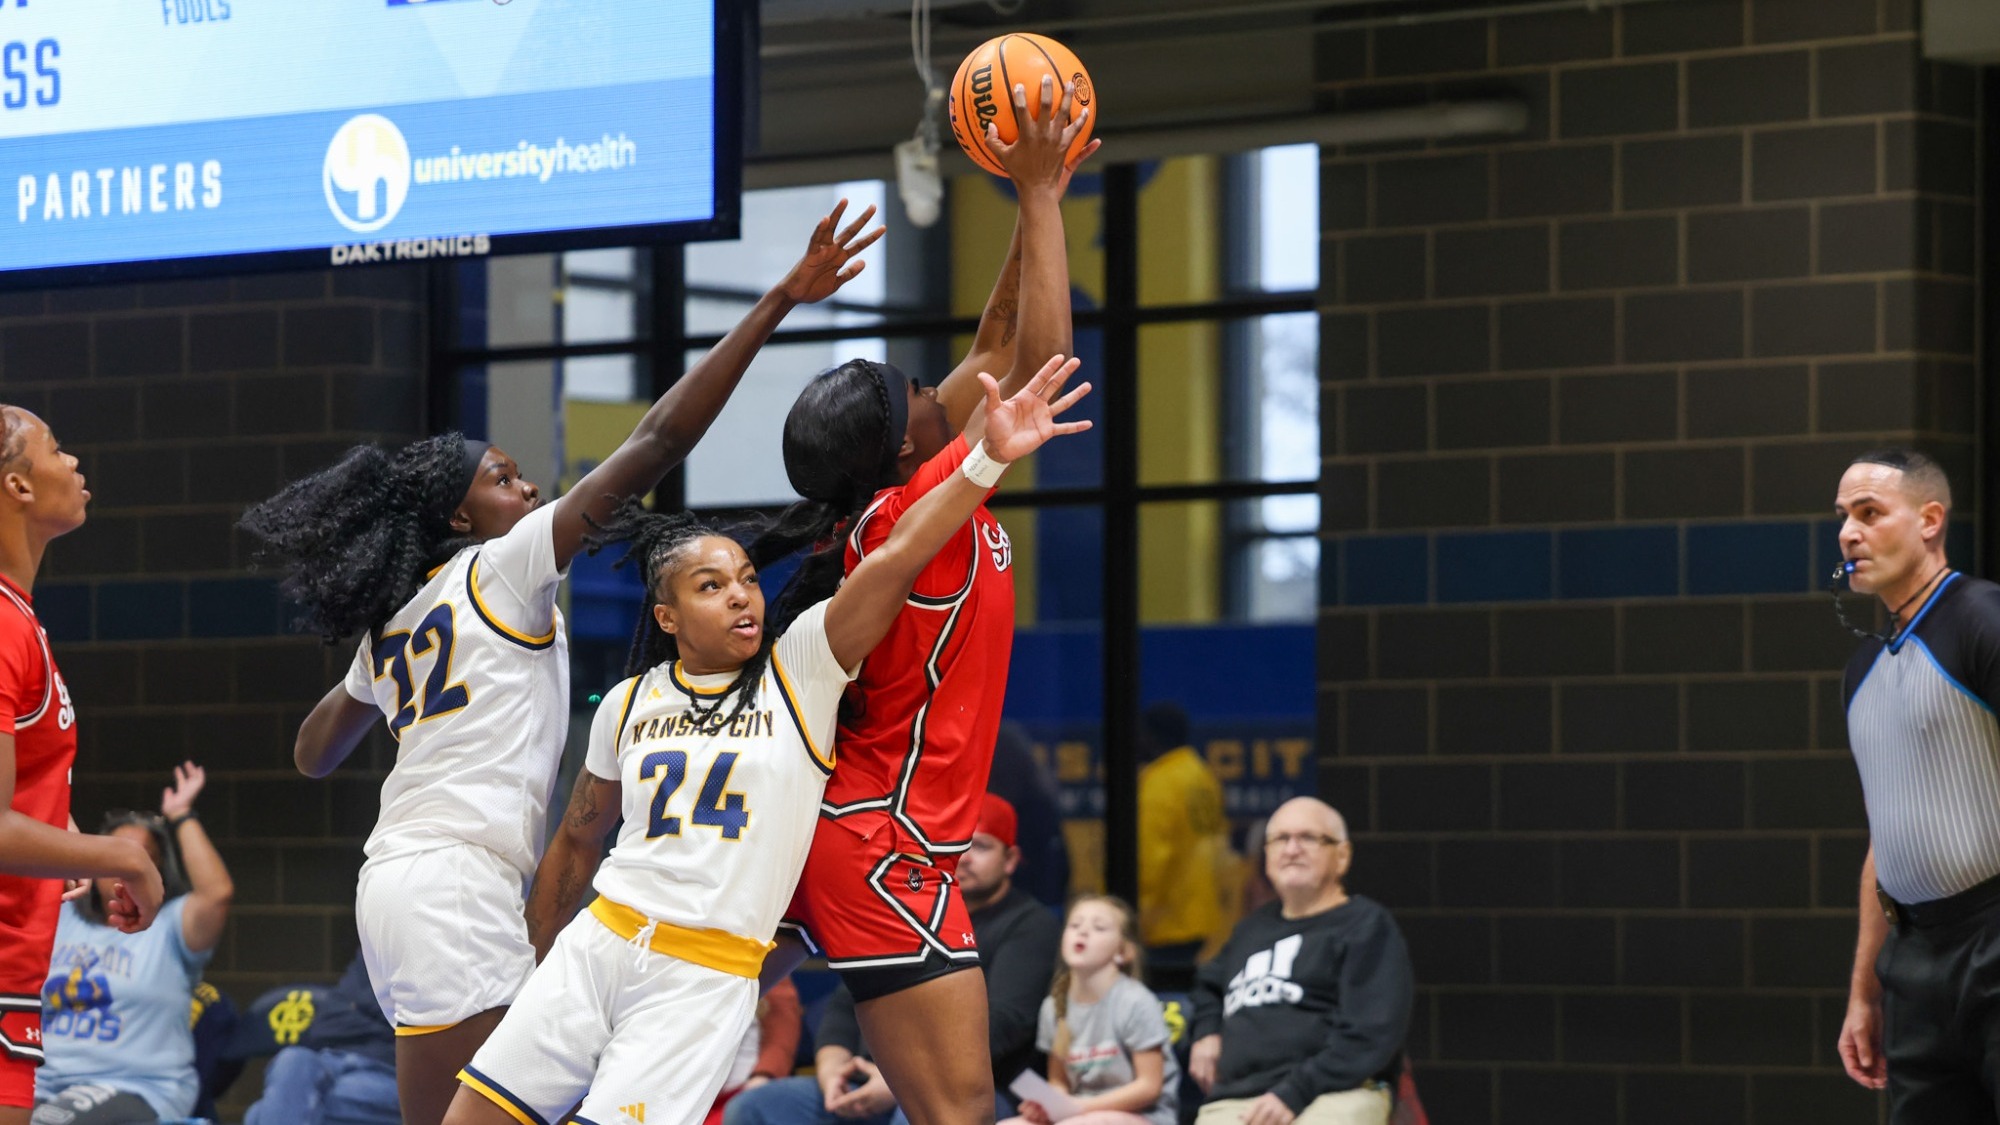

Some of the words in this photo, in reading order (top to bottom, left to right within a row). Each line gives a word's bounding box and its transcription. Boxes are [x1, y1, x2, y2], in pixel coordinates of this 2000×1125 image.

[18, 159, 223, 223] PARTNERS
[331, 234, 491, 266] DAKTRONICS
[638, 749, 752, 843] 24
